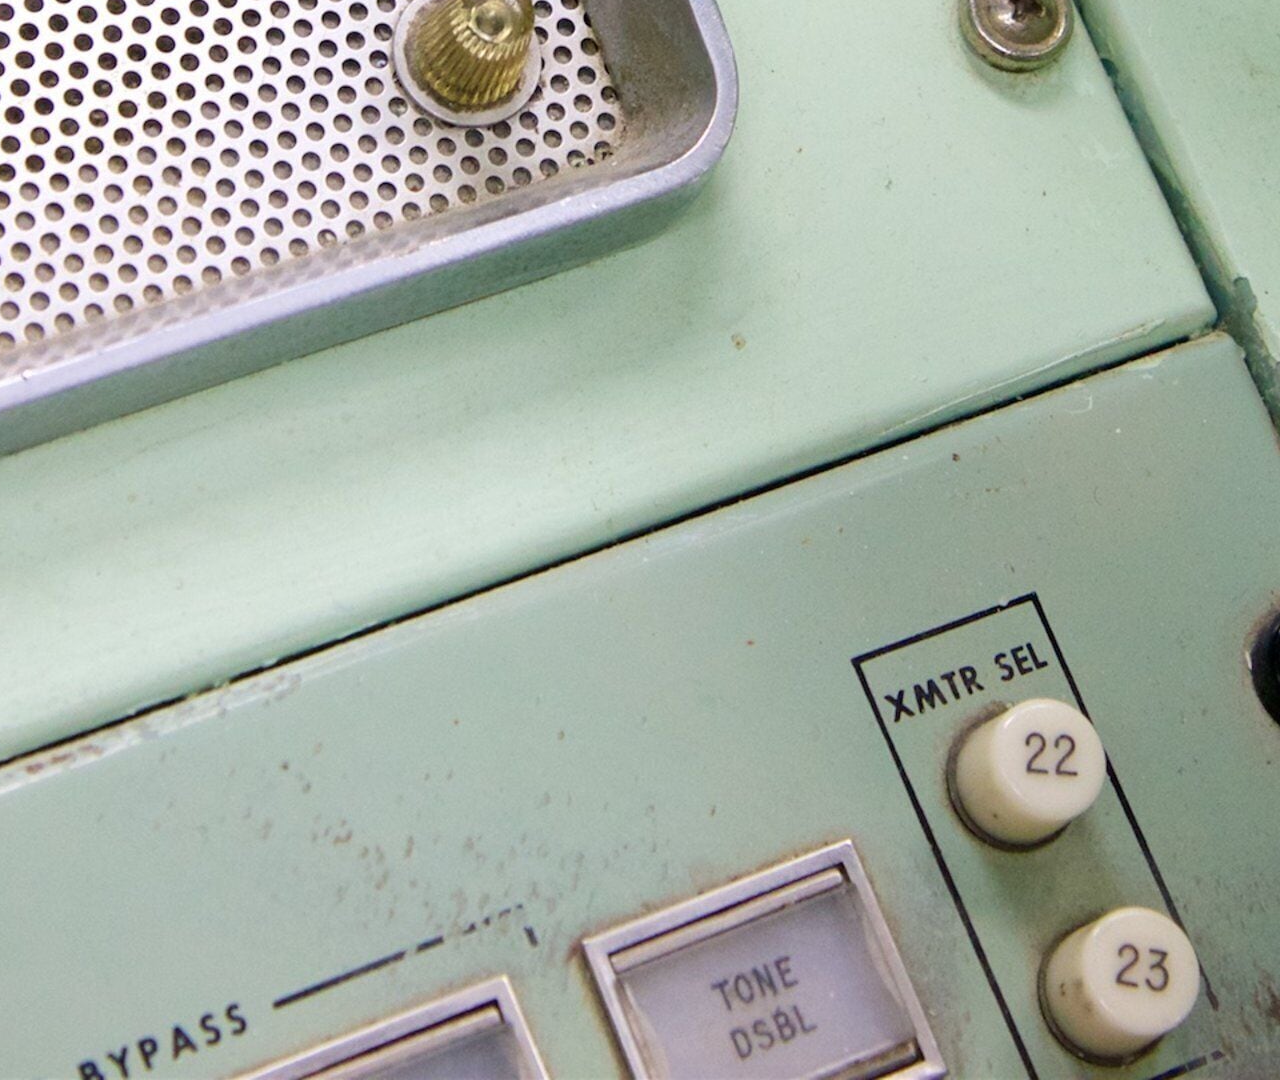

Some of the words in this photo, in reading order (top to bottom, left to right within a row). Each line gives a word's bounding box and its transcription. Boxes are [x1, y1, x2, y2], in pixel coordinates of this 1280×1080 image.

[884, 665, 985, 723] XMTR
[993, 642, 1049, 682] SEL
[1024, 732, 1079, 777] 22
[710, 955, 799, 1012] TONE
[1115, 943, 1170, 992] 23
[77, 1003, 248, 1080] BYPASS
[729, 1005, 818, 1061] DSBL
